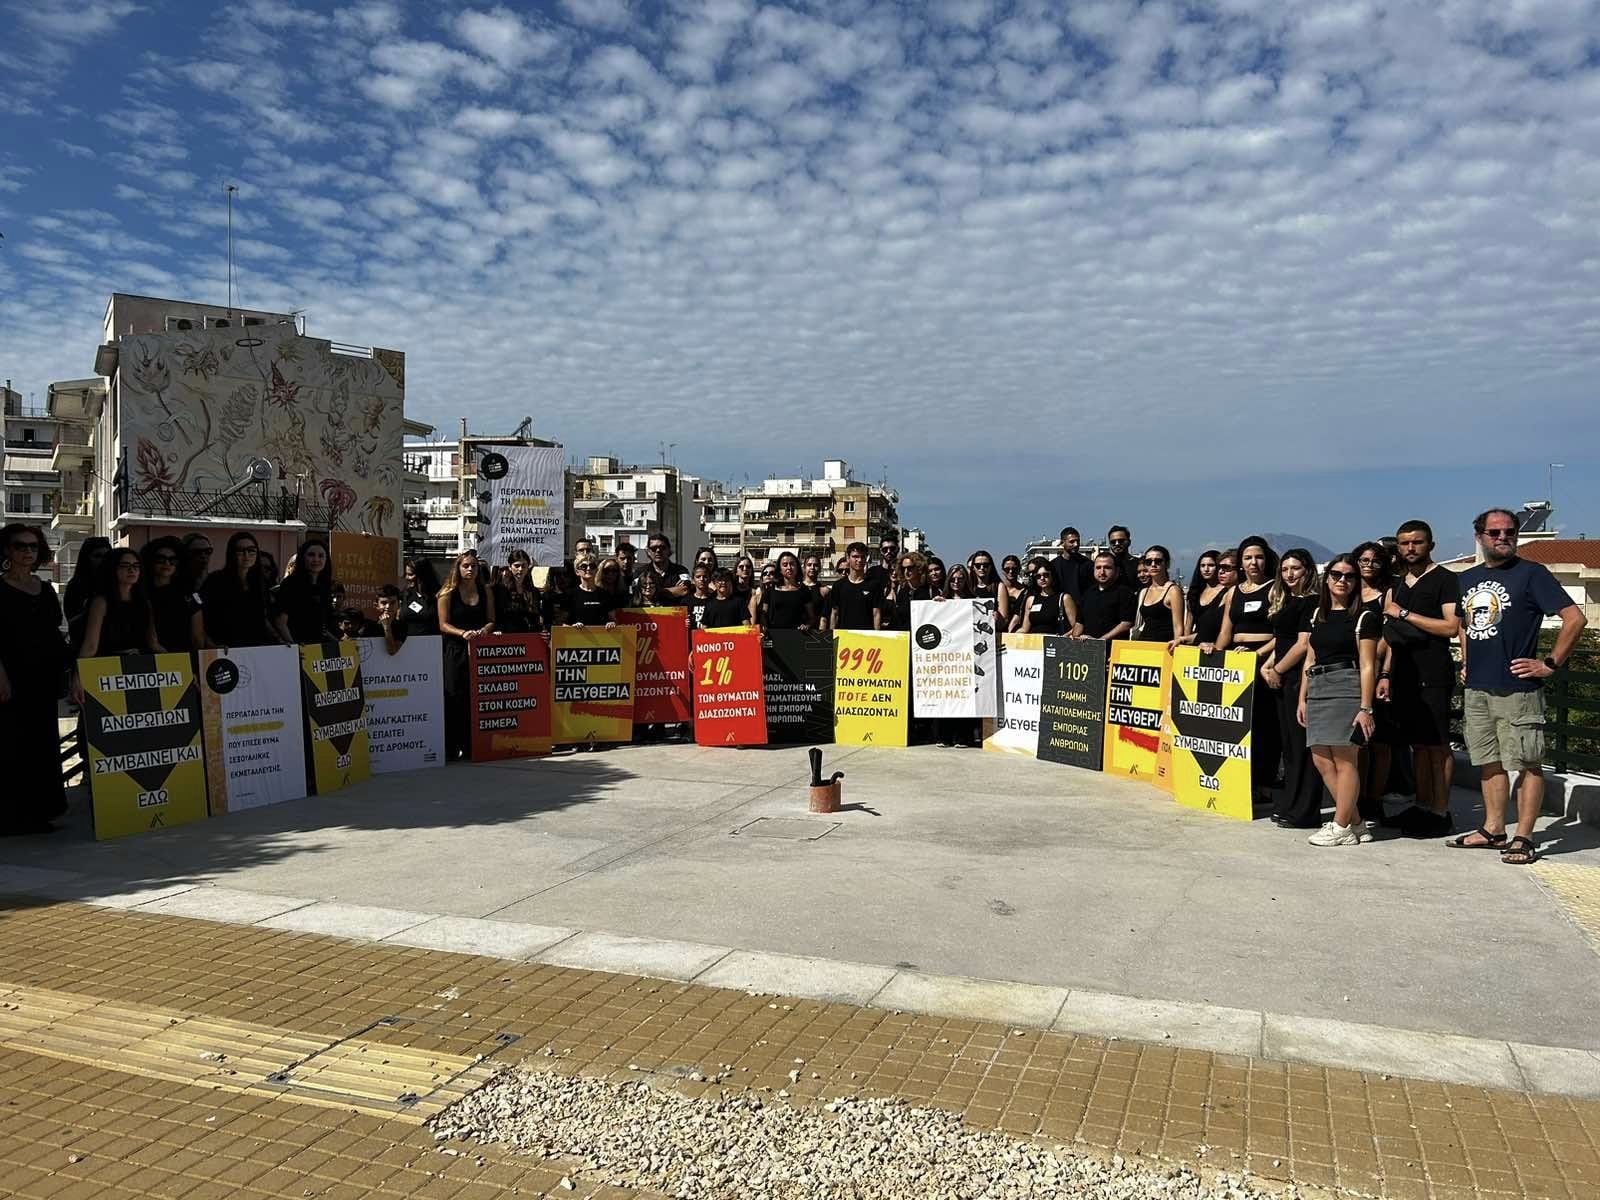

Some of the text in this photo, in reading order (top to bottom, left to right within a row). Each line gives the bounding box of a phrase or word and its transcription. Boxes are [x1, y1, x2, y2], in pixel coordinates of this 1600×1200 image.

[500, 488, 554, 497] ΠΕΡΠΑΤΑΩ ΓΙΑ
[500, 497, 511, 505] ΤΗ
[500, 517, 560, 526] ΣΤΟ ΔΙΚΑΣΤΗΡΙΟ
[500, 527, 535, 535] ΕΝΑΝΤΙΑ
[500, 536, 545, 544] ΔΙΑΚΙΝΗΤΕΣ
[1477, 580, 1512, 610] SCHOOL
[692, 605, 706, 614] JUS
[645, 622, 658, 631] ΤΟ
[477, 646, 526, 656] ΥΠΑΡΧΟΥΝ
[696, 641, 734, 653] ΜΟΝΟ ΤΟ
[556, 649, 620, 663] ΜΑΖΙ ΓΙΑ
[839, 648, 883, 674] 99%
[915, 653, 972, 663] Η ΕΜΠΟΡΙΑ
[312, 657, 353, 672] Η ΕΜΠΟΡΙΑ
[477, 664, 544, 675] ΕΚΑΤΟΜΜΥΡΙΑ
[700, 656, 733, 686] 1%
[915, 664, 973, 675] ΑΝΘΡΩΠΩΝ
[556, 668, 586, 682] ΤΗΝ
[636, 671, 685, 681] ΘΥΜΑΤΩΝ
[1014, 667, 1041, 679] ΜΑΖΙ
[1058, 662, 1089, 682] 1109
[1112, 665, 1161, 685] ΜΑΖΙ ΓΙΑ
[1183, 666, 1240, 683] Η ΕΜΠΟΡΙΑ
[100, 672, 180, 691] Η ΕΜΠΟΡΙΑ
[363, 673, 429, 685] ΕΡΠΑΤΑΩ ΓΙΑ ΤΟ
[836, 678, 902, 689] ΤΩΝ ΘΥΜΑΤΩΝ
[916, 677, 972, 687] ΣΥΜΒΑΙΝΕΙ
[478, 682, 519, 693] ΣΚΛΑΒΟΙ
[555, 687, 629, 700] ΕΛΕΥΘΕΡΙΑ
[634, 686, 680, 697] ΩΖΟΝΤΑΙ
[805, 683, 817, 692] ΝΑ
[315, 689, 359, 706] ΑΝΘΡΩΠΩΝ
[698, 690, 759, 704] ΤΩΝ ΘΥΜΑΤΩΝ
[766, 694, 822, 702] ΤΑΜΑΤΗΣΟΥΜΕ
[838, 692, 892, 703] ΠΟΤΕ ΔΕΝ
[1005, 692, 1039, 705] ΓΙΑ ΤΗ
[1057, 690, 1087, 702] ΓΡΑΜΜΗ
[1110, 687, 1132, 702] ΤΗΝ
[364, 704, 375, 713] ΟΥ
[478, 698, 537, 711] ΣΤΟΝ ΚΟΣΜΟ
[766, 704, 813, 713] ΗΝ ΕΜΠΟΡΙΑ
[1179, 701, 1240, 721] ΑΝΘΡΩΠΩΝ
[260, 708, 271, 717] ΓΙΑ
[271, 706, 284, 715] ΤΗΝ
[698, 707, 757, 720] ΔΙΑΣΩΖΟΝΤΑΙ
[836, 706, 898, 718] ΔΙΑΣΩΖΟΝΤΑΙ
[1042, 703, 1101, 721] ΚΑΤΑΠΟΛΕΜΗΣΗΣ
[102, 710, 186, 732] ΑΝΘΡΩΠΩΝ
[367, 713, 428, 726] ΑΝΑΓΚΑΣΤΗΚΕ
[479, 717, 518, 730] ΣΗΜΕΡΑ
[767, 714, 805, 723] ΝΘΡΩΠΩΝ.
[997, 717, 1041, 732] ΕΛΕΥΘΕ
[313, 720, 352, 741] ΣΥΜΒΑΙΝΕΙ
[352, 718, 366, 731] ΚΑΙ
[372, 729, 405, 740] ΕΠΑΙΤΕΙ
[1053, 723, 1088, 736] ΕΜΠΟΡΙΑΣ
[228, 737, 280, 750] ΠΟΥ ΕΠΕΣΕ ΘΥΜΑ
[368, 740, 427, 754] ΟΥΣ ΔΡΟΜΟΥΣ.
[1050, 739, 1089, 753] ΑΝΘΡΩΠΩΝ
[1174, 735, 1226, 755] ΣΥΜΒΑΙΝΕΙ
[1228, 744, 1247, 759] ΚΑΙ
[95, 746, 199, 774] ΣΥΜΒΑΙΝΕΙ ΚΑΙ
[336, 755, 352, 769] ΕΔΩ
[1199, 774, 1220, 791] ΕΔΩ
[138, 790, 168, 808] ΕΔΩ
